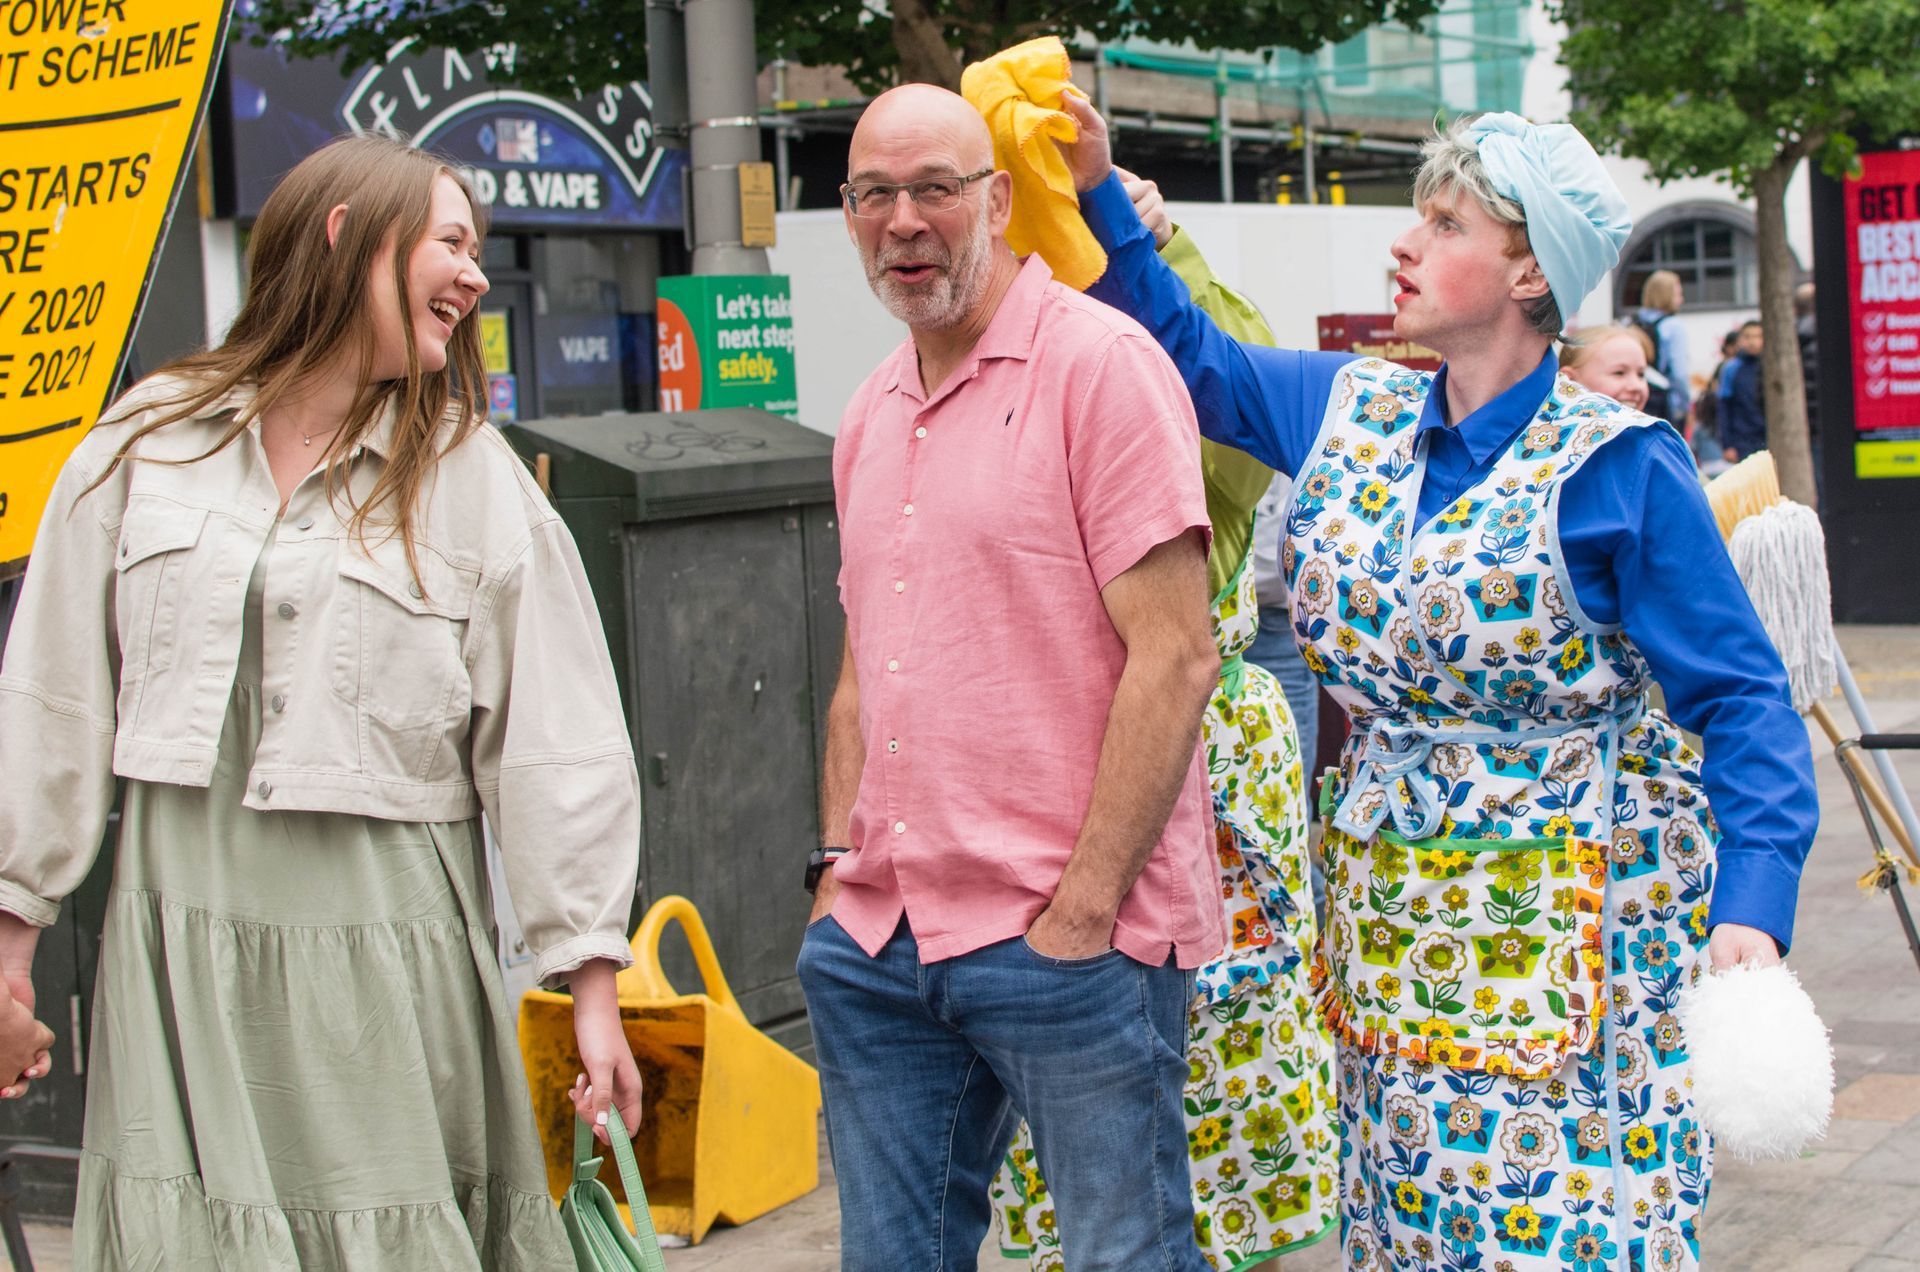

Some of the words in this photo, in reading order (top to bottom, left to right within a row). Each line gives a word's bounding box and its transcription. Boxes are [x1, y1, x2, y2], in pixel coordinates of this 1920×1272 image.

[38, 22, 200, 87] SCHEME
[504, 169, 529, 207] &
[528, 170, 600, 210] VAPE
[1860, 182, 1907, 221] GET
[21, 280, 105, 336] 2020
[716, 293, 761, 320] Let's
[558, 335, 610, 363] VAPE
[717, 324, 761, 350] next
[20, 341, 96, 398] 2021
[718, 351, 778, 384] safely.
